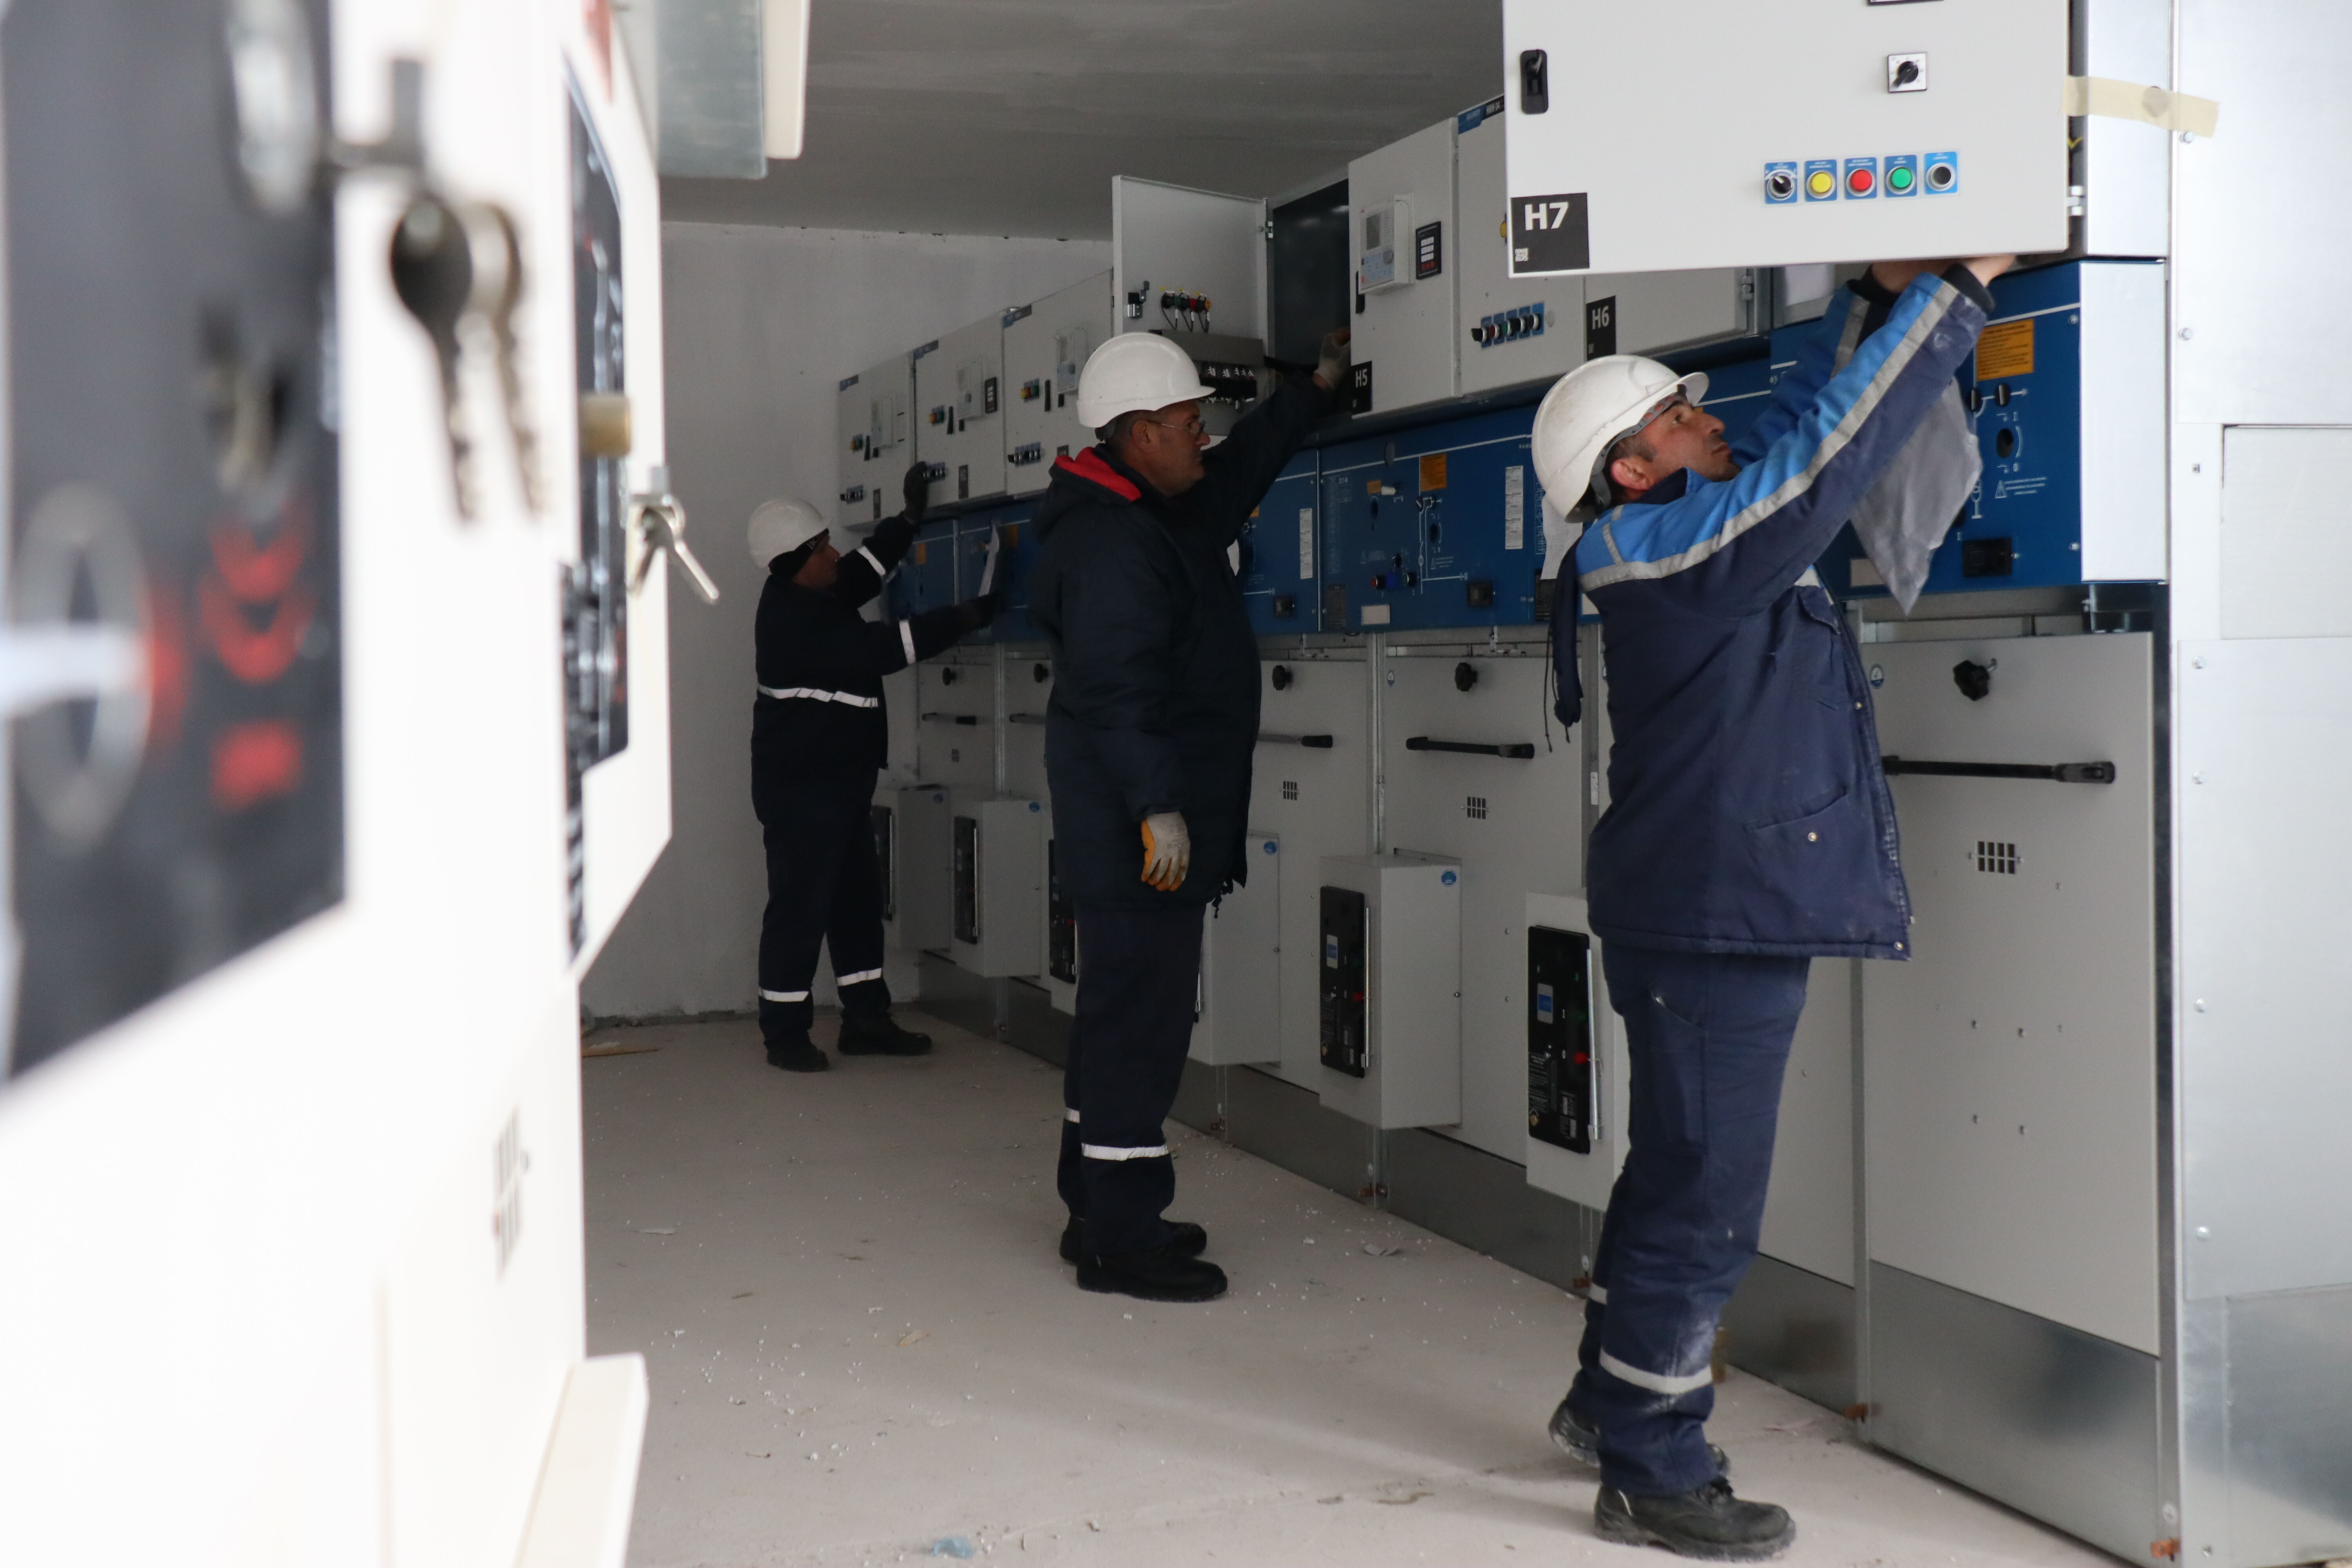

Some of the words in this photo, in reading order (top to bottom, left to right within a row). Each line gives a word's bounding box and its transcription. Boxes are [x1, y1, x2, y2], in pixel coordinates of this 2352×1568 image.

[1524, 201, 1569, 231] H7
[1592, 306, 1609, 330] H6
[1356, 368, 1367, 388] H5
